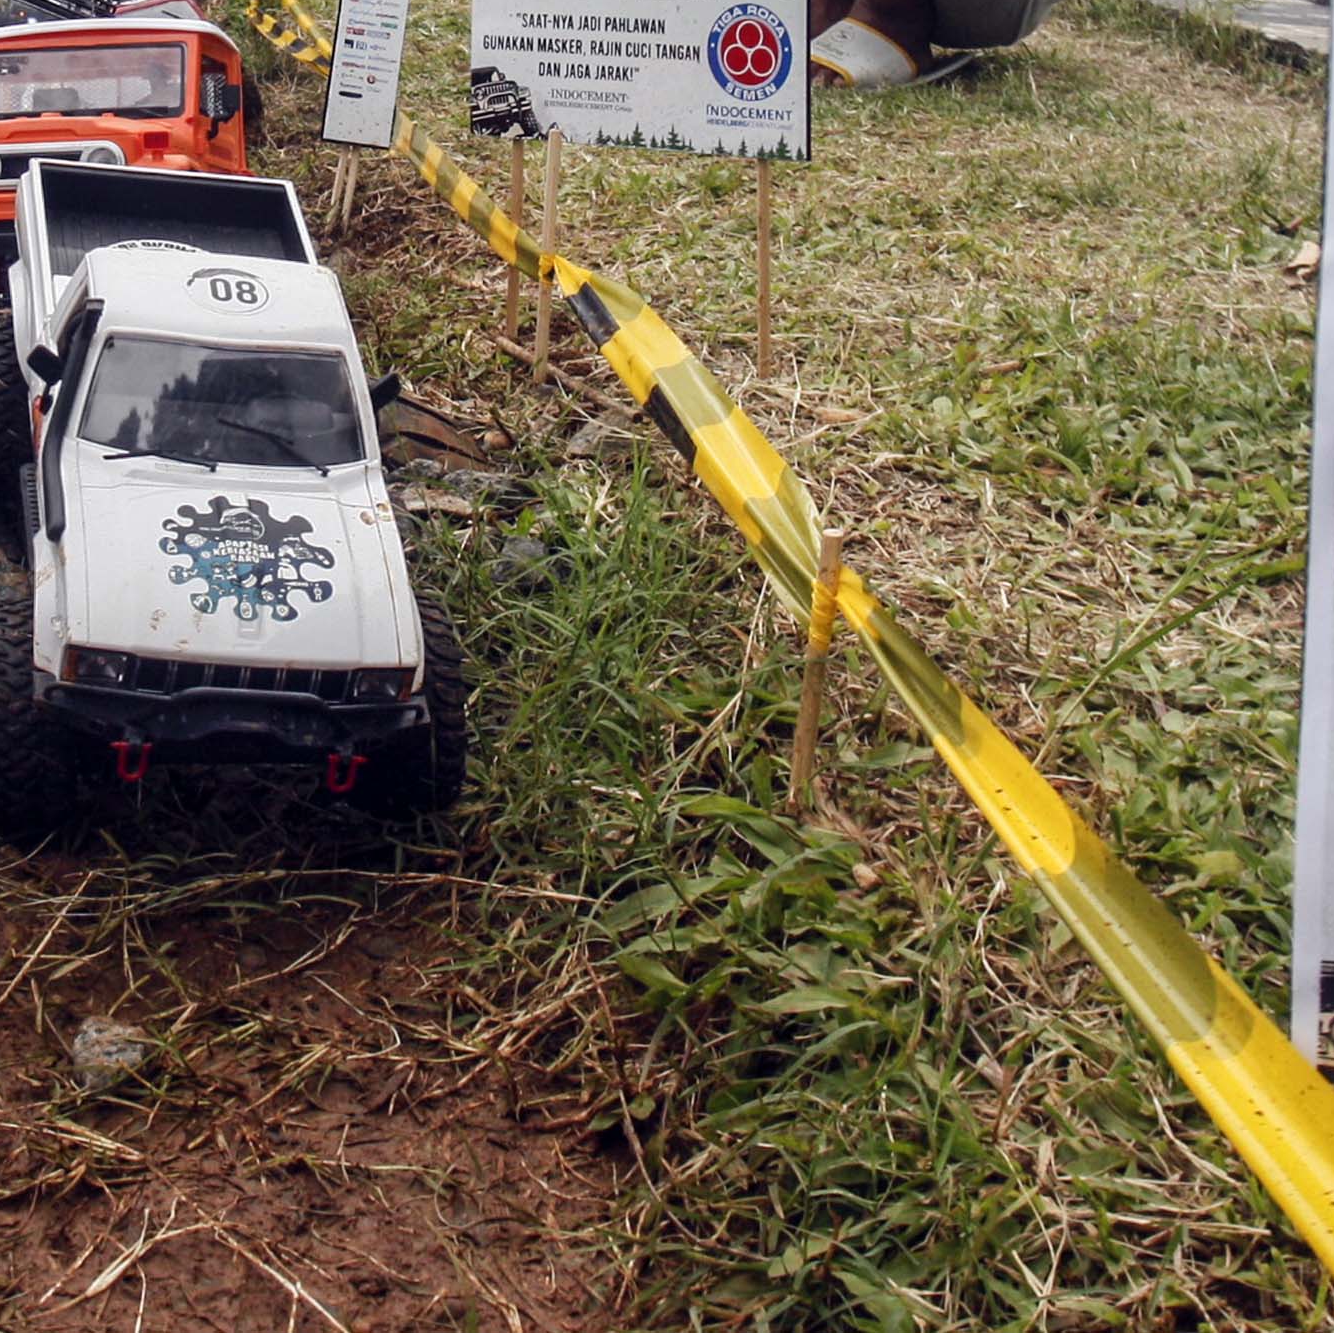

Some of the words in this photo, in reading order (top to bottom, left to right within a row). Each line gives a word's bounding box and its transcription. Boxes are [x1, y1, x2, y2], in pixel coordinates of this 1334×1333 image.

[577, 14, 601, 32] JADI
[605, 15, 666, 35] PAHLAWAN
[711, 6, 743, 33] TIGA
[747, 5, 785, 39] RODA
[483, 34, 534, 52] GUNAKAN
[537, 37, 586, 57] MASKER,
[589, 39, 622, 57] RAJIN
[625, 40, 651, 59] CUCI
[654, 42, 701, 64] TANGAN
[538, 62, 560, 78] DAN
[564, 62, 591, 80] JAGA
[725, 81, 778, 102] SEMEN
[706, 104, 793, 122] INDOCEMENT
[209, 277, 259, 305] 08
